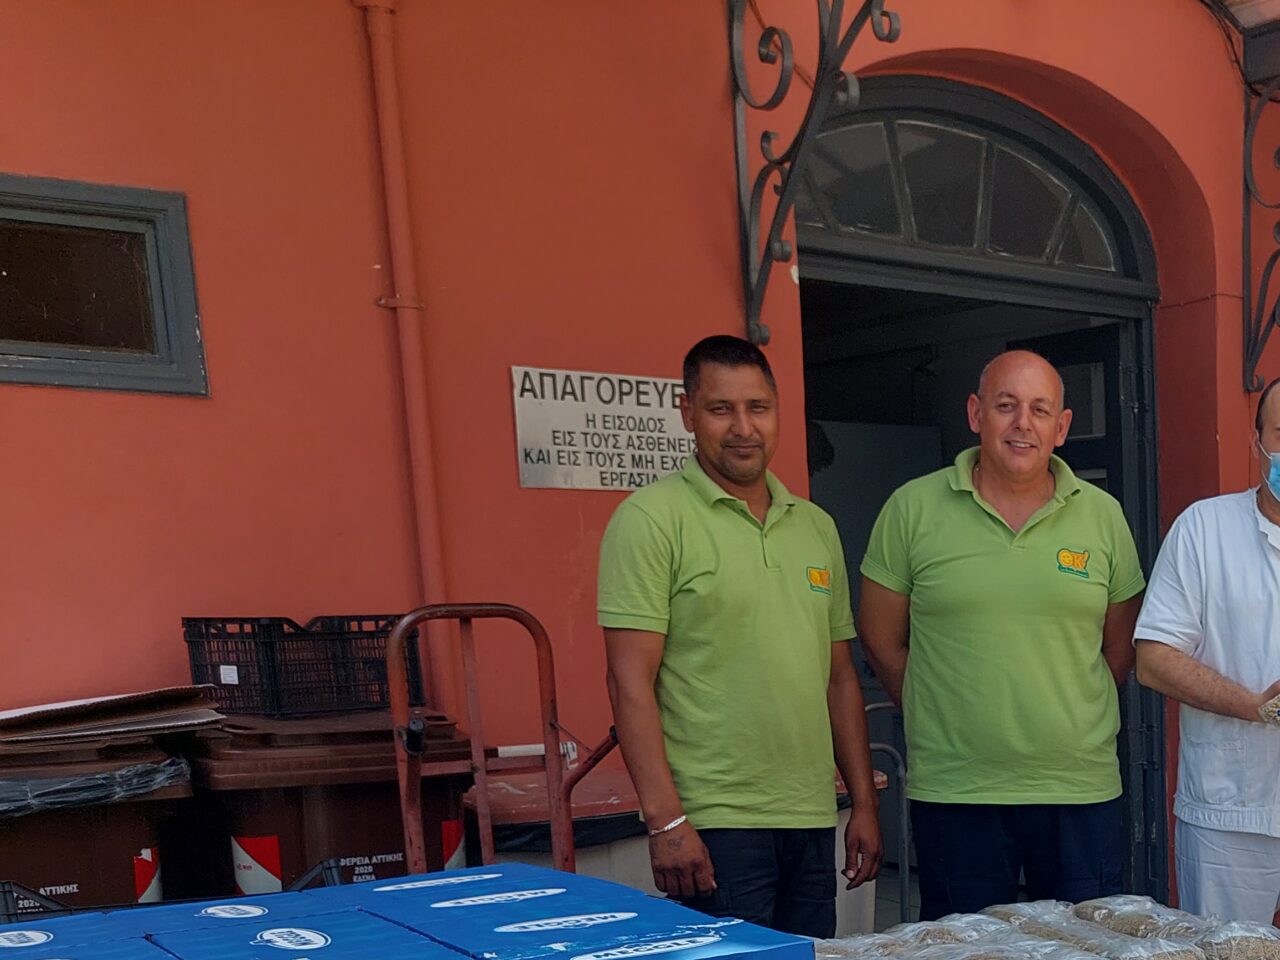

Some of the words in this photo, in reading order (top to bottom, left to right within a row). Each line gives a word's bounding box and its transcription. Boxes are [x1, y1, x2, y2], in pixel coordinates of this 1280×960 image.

[586, 413, 596, 429] Η
[603, 414, 667, 433] ΕΙΣΟΔΟΣ
[552, 430, 577, 447] ΕΙΣ
[580, 432, 622, 450] ΤΟΥΣ
[626, 436, 698, 454] ΑΣΘΕΝΕΙΣ
[523, 448, 550, 465] ΚΑΙ
[557, 450, 581, 466] ΕΙΣ
[585, 451, 626, 469] ΤΟΥΣ
[631, 455, 654, 470] ΜΗ
[371, 853, 403, 864] ΑΤΤΙΚΗΣ
[354, 865, 373, 875] 2020
[593, 938, 704, 960] MEGGLE
